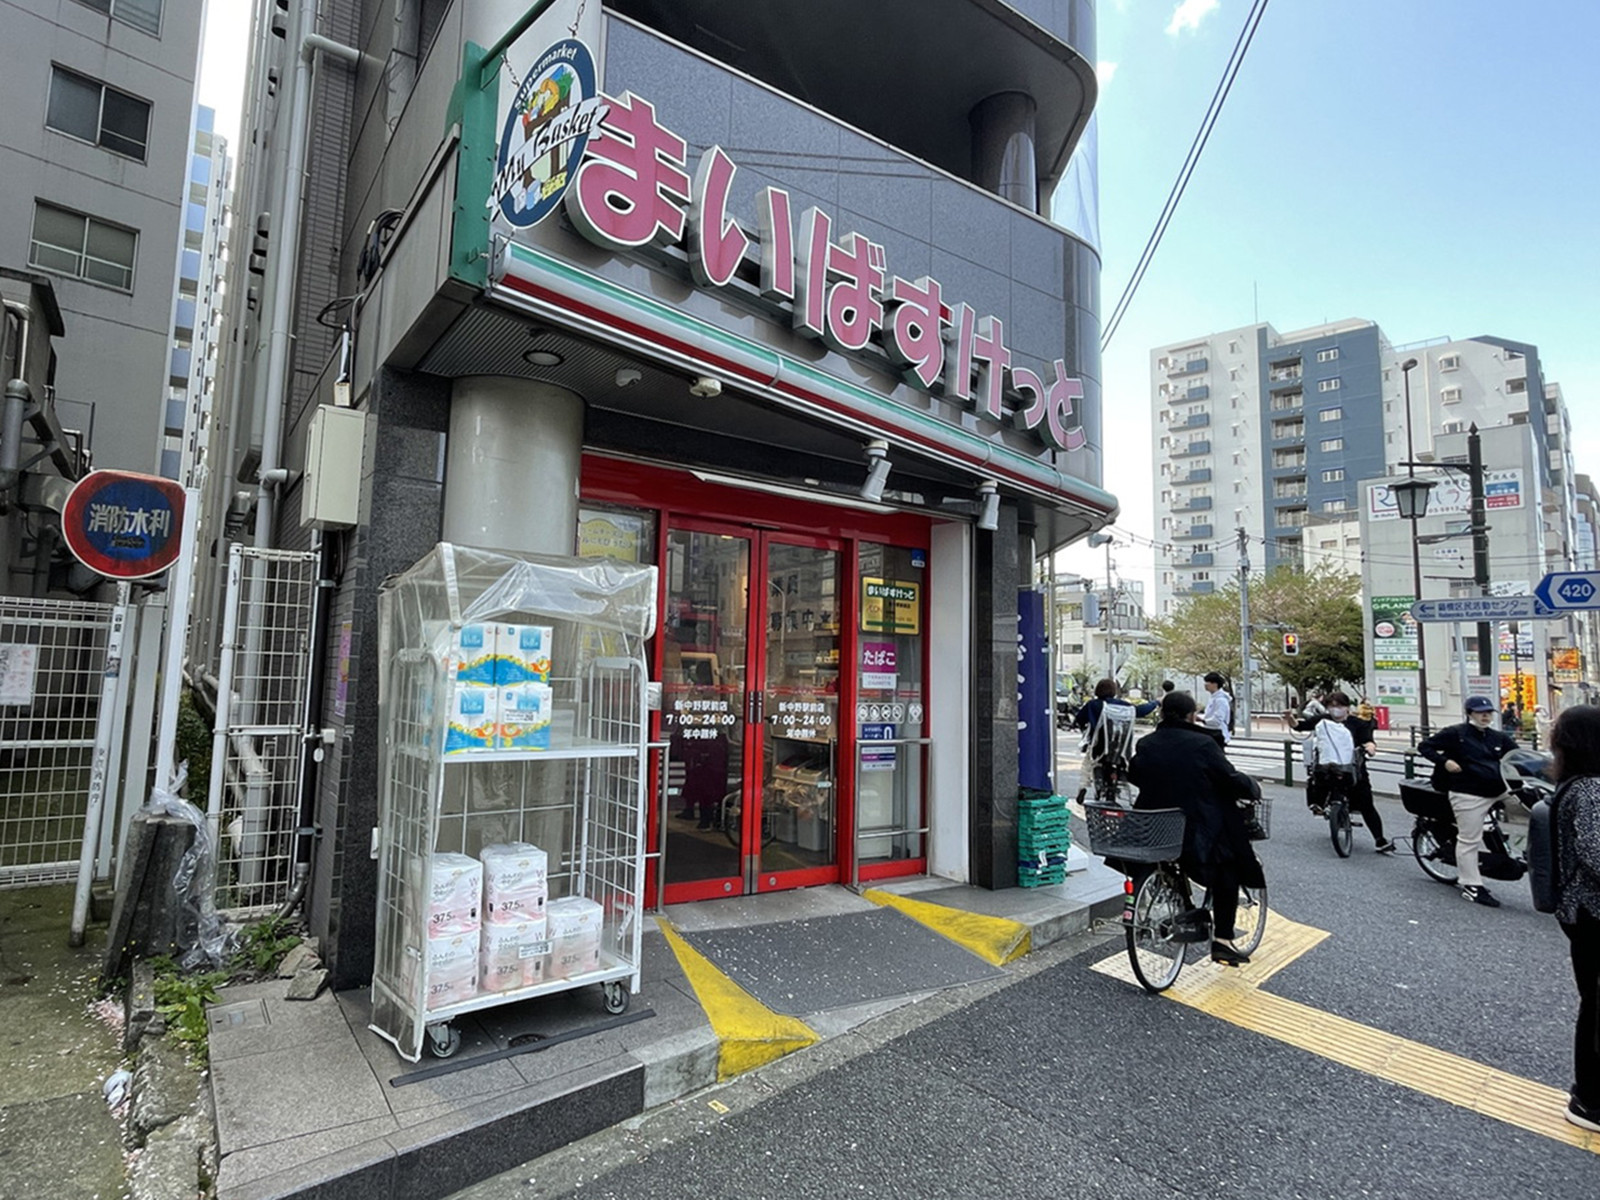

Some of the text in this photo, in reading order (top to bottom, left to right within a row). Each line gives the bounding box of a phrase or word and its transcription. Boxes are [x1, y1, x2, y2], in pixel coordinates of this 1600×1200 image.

[491, 103, 598, 201] My Basket
[571, 90, 1086, 452] まいばすけっと
[87, 502, 171, 538] 消防水利
[867, 585, 915, 600] まいばすけっと
[1562, 584, 1592, 597] 420
[863, 650, 896, 666] たばこ
[674, 700, 729, 712] 新中野駅前店
[778, 703, 825, 713] 新中野駅前店
[682, 728, 719, 740] 年中無休
[785, 728, 818, 739] 年中無休
